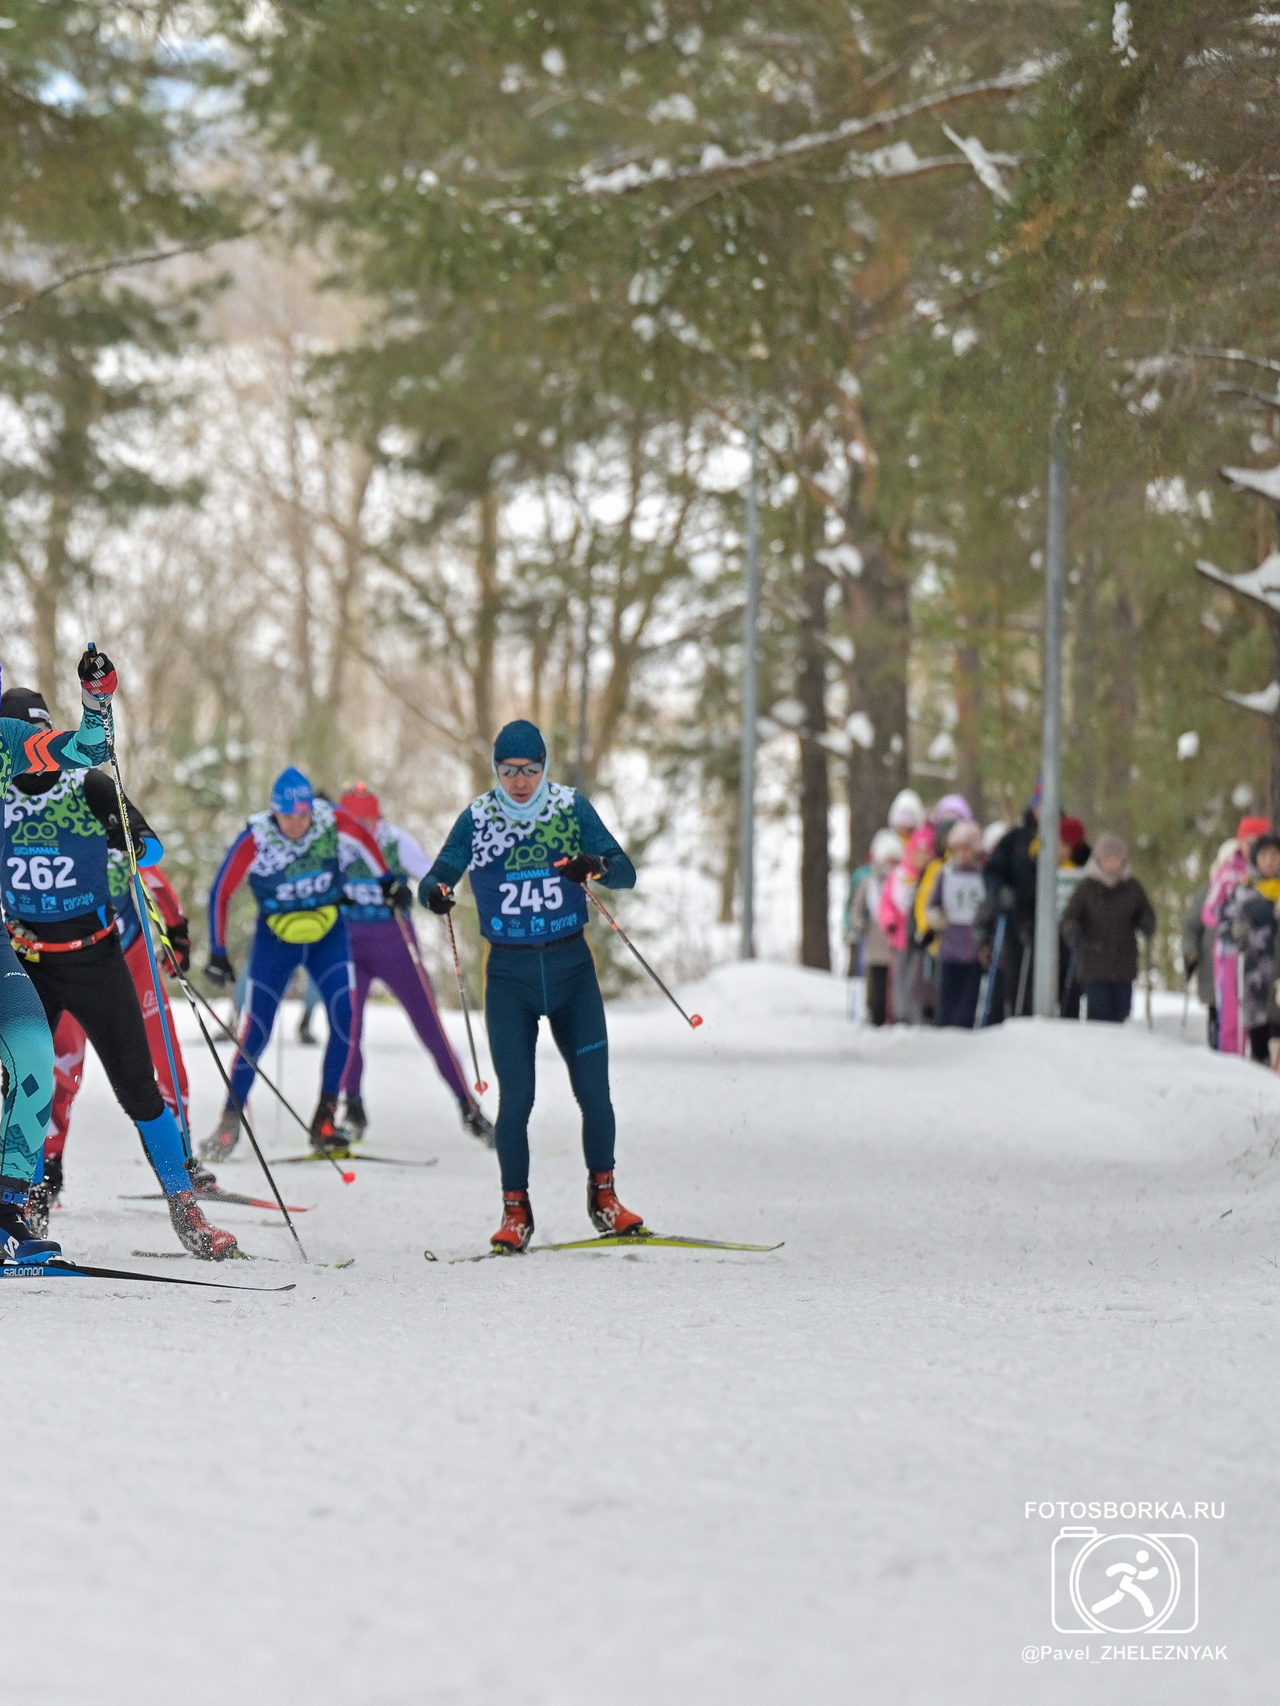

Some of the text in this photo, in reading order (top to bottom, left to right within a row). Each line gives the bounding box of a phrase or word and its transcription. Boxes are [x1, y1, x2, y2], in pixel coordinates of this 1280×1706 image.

[6, 855, 77, 891] 262
[498, 876, 564, 915] 245
[3, 1266, 45, 1277] salomon
